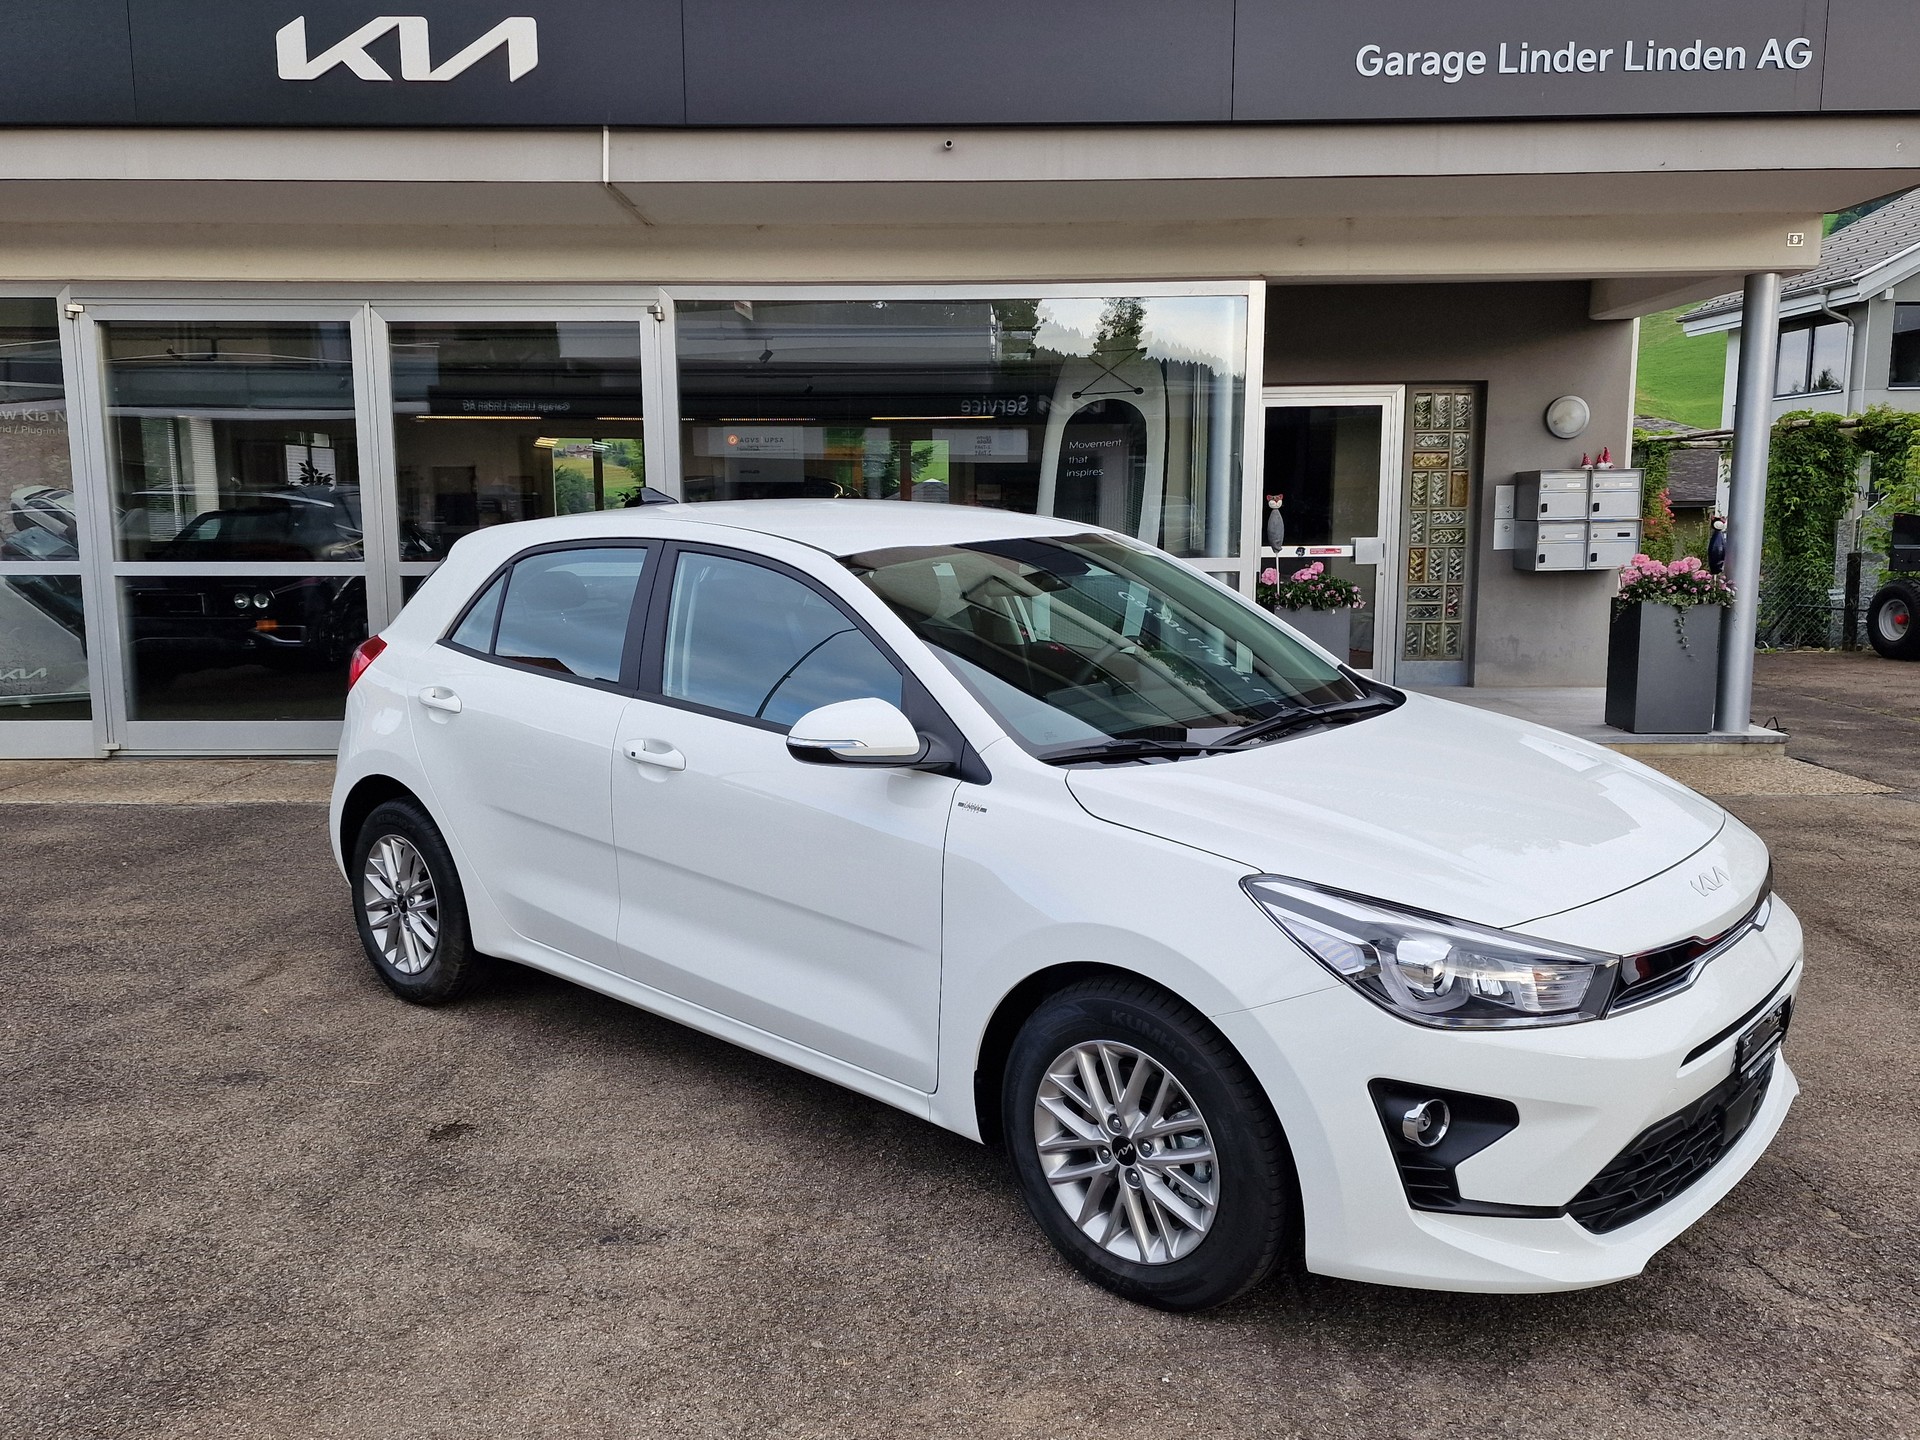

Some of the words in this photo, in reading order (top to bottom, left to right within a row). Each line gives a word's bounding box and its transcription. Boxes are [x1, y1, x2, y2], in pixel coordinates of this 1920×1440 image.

[276, 15, 539, 82] KIA
[1356, 44, 1487, 83] Garage
[1498, 41, 1614, 74] Linder
[1624, 39, 1746, 72] Linden
[1756, 37, 1813, 70] AG
[22, 408, 49, 422] Kia
[21, 425, 55, 436] Plug-in
[1069, 439, 1122, 449] Movement
[1068, 455, 1088, 464] that
[1066, 469, 1104, 478] inspires
[1111, 1009, 1190, 1062] KUMHO
